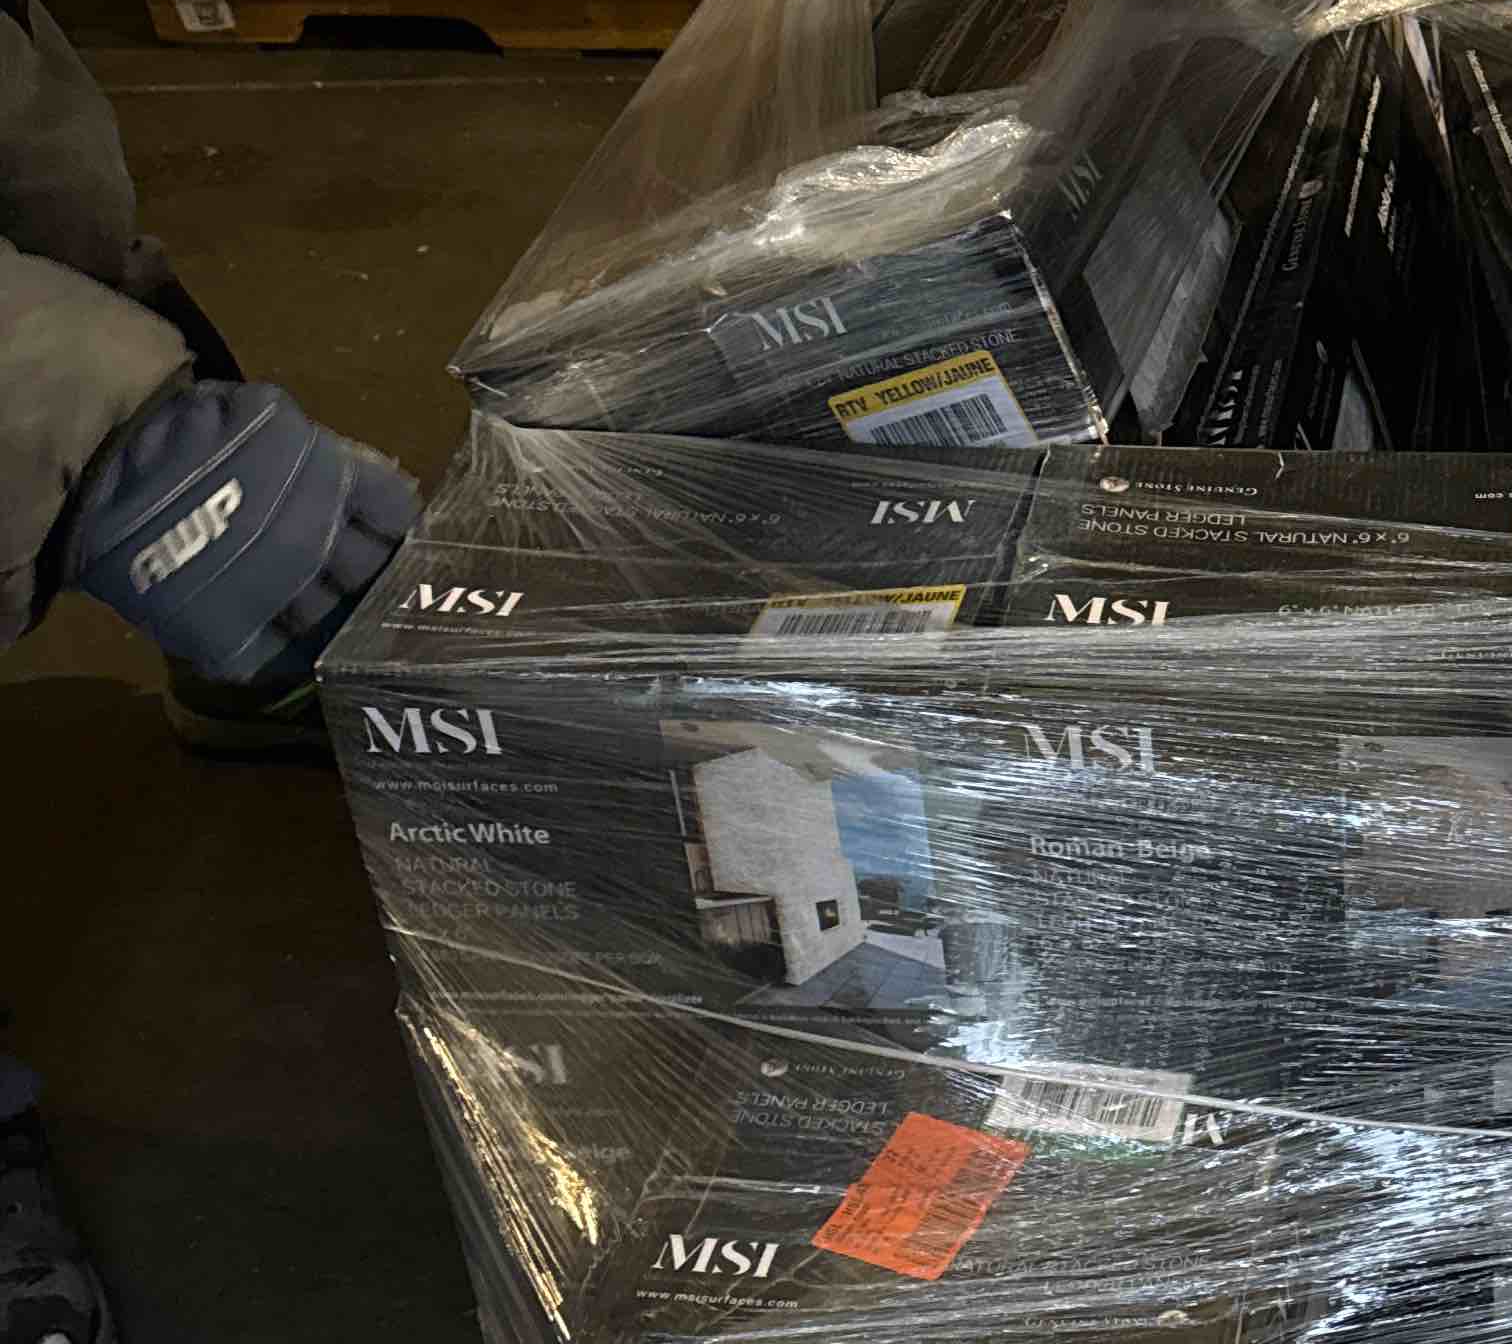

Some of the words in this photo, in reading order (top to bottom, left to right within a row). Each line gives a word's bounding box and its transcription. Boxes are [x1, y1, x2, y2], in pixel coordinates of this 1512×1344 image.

[752, 296, 848, 353] MSI
[874, 358, 996, 406] YELLOW/JAUNE
[870, 498, 976, 526] MSI
[1080, 502, 1161, 522] PANELS
[1166, 510, 1248, 527] LEDGER
[1077, 517, 1148, 536] STONE
[1152, 524, 1250, 544] STACKED
[1256, 528, 1350, 545] NATURAL
[399, 583, 526, 617] MSI
[1045, 594, 1175, 627] MSI
[359, 705, 503, 756] MSI
[1021, 724, 1159, 775] MSI
[389, 821, 467, 844] Arctic
[467, 822, 551, 845] White
[1029, 836, 1124, 858] Roman
[650, 1232, 780, 1279] MSI
